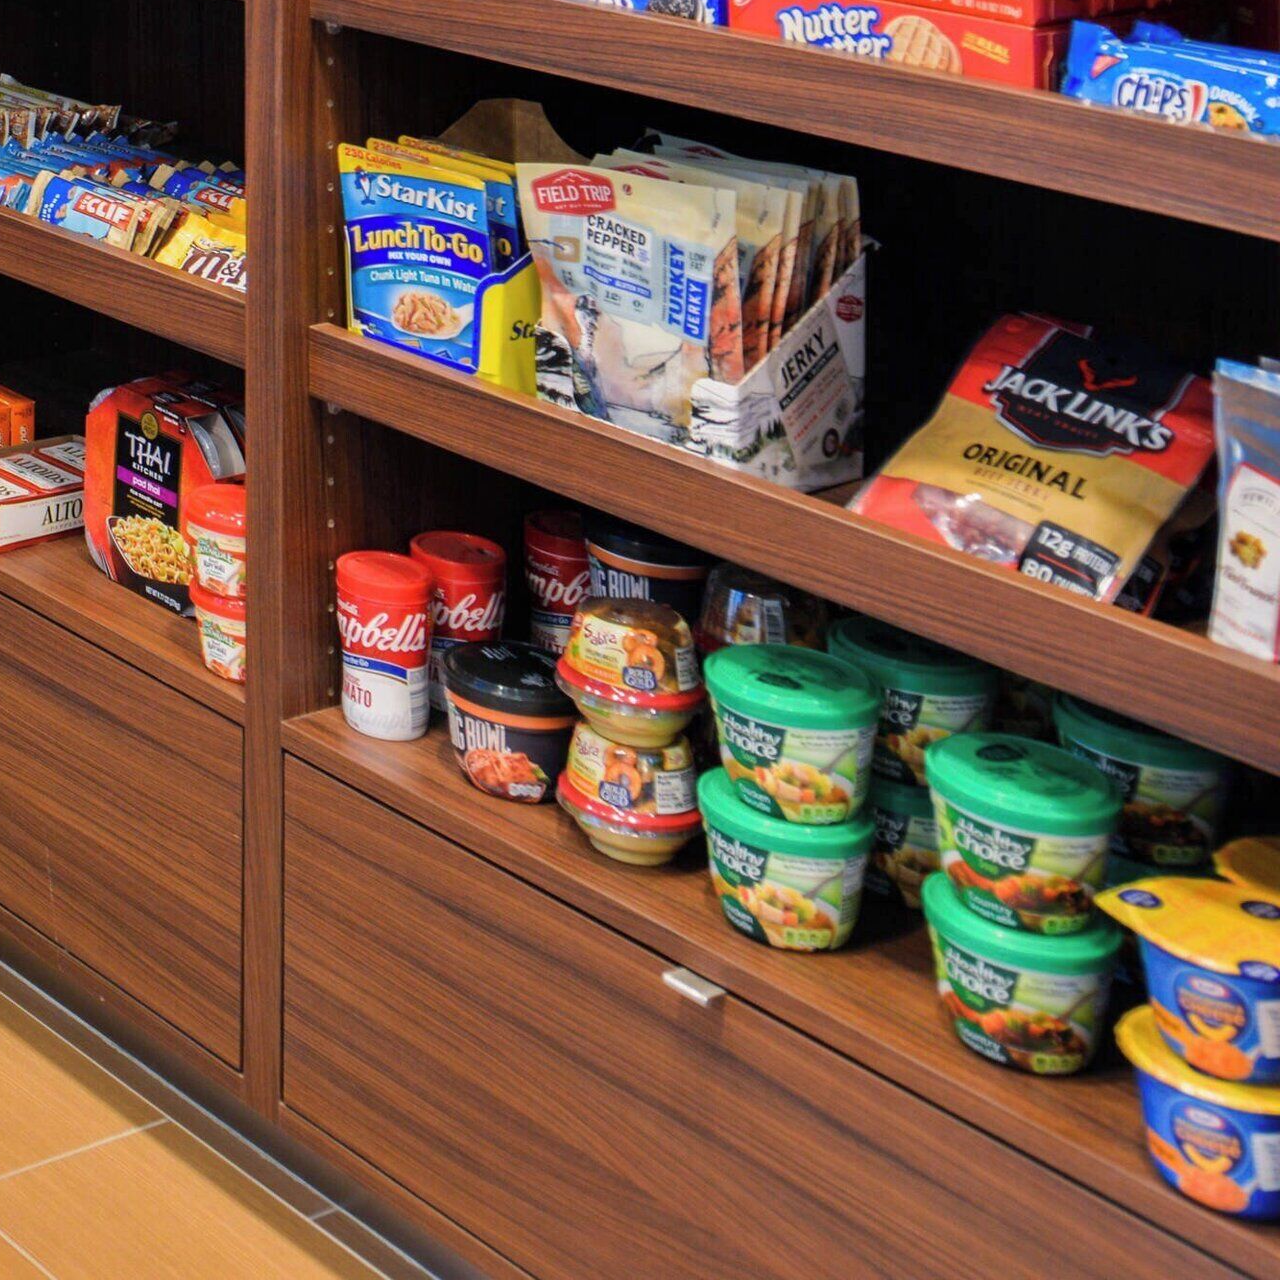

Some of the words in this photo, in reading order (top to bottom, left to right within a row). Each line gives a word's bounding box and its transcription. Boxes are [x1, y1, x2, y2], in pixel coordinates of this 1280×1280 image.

[777, 6, 877, 43] Nutter
[1117, 74, 1188, 116] Chips
[344, 146, 364, 159] 230
[365, 152, 402, 170] Calories
[88, 194, 130, 226] CLIF
[376, 175, 478, 222] StarKist
[537, 186, 578, 204] FIELD
[581, 185, 612, 201] TRIP
[587, 215, 646, 246] CRACKED
[587, 228, 636, 258] PEPPER
[388, 251, 401, 261] MIX
[403, 252, 427, 263] YOUR
[429, 255, 451, 267] OWN
[370, 270, 394, 281] Chunk
[396, 270, 417, 284] Light
[420, 272, 440, 285] Tuna
[453, 278, 476, 294] Wate
[668, 243, 686, 326] TURKEY
[688, 282, 705, 335] JERKY
[780, 328, 825, 389] JERKY
[984, 366, 1059, 411] JACK
[1060, 392, 1173, 452] LINK'S
[124, 431, 171, 474] THAI
[132, 463, 163, 483] KITCHEN
[963, 442, 1088, 501] ORIGINAL
[1038, 525, 1071, 558] 12g
[1020, 557, 1051, 584] 80
[337, 612, 427, 653] mpbell's
[584, 623, 617, 645] Sabra
[465, 718, 508, 753] BOWL
[953, 829, 1025, 870] Choice
